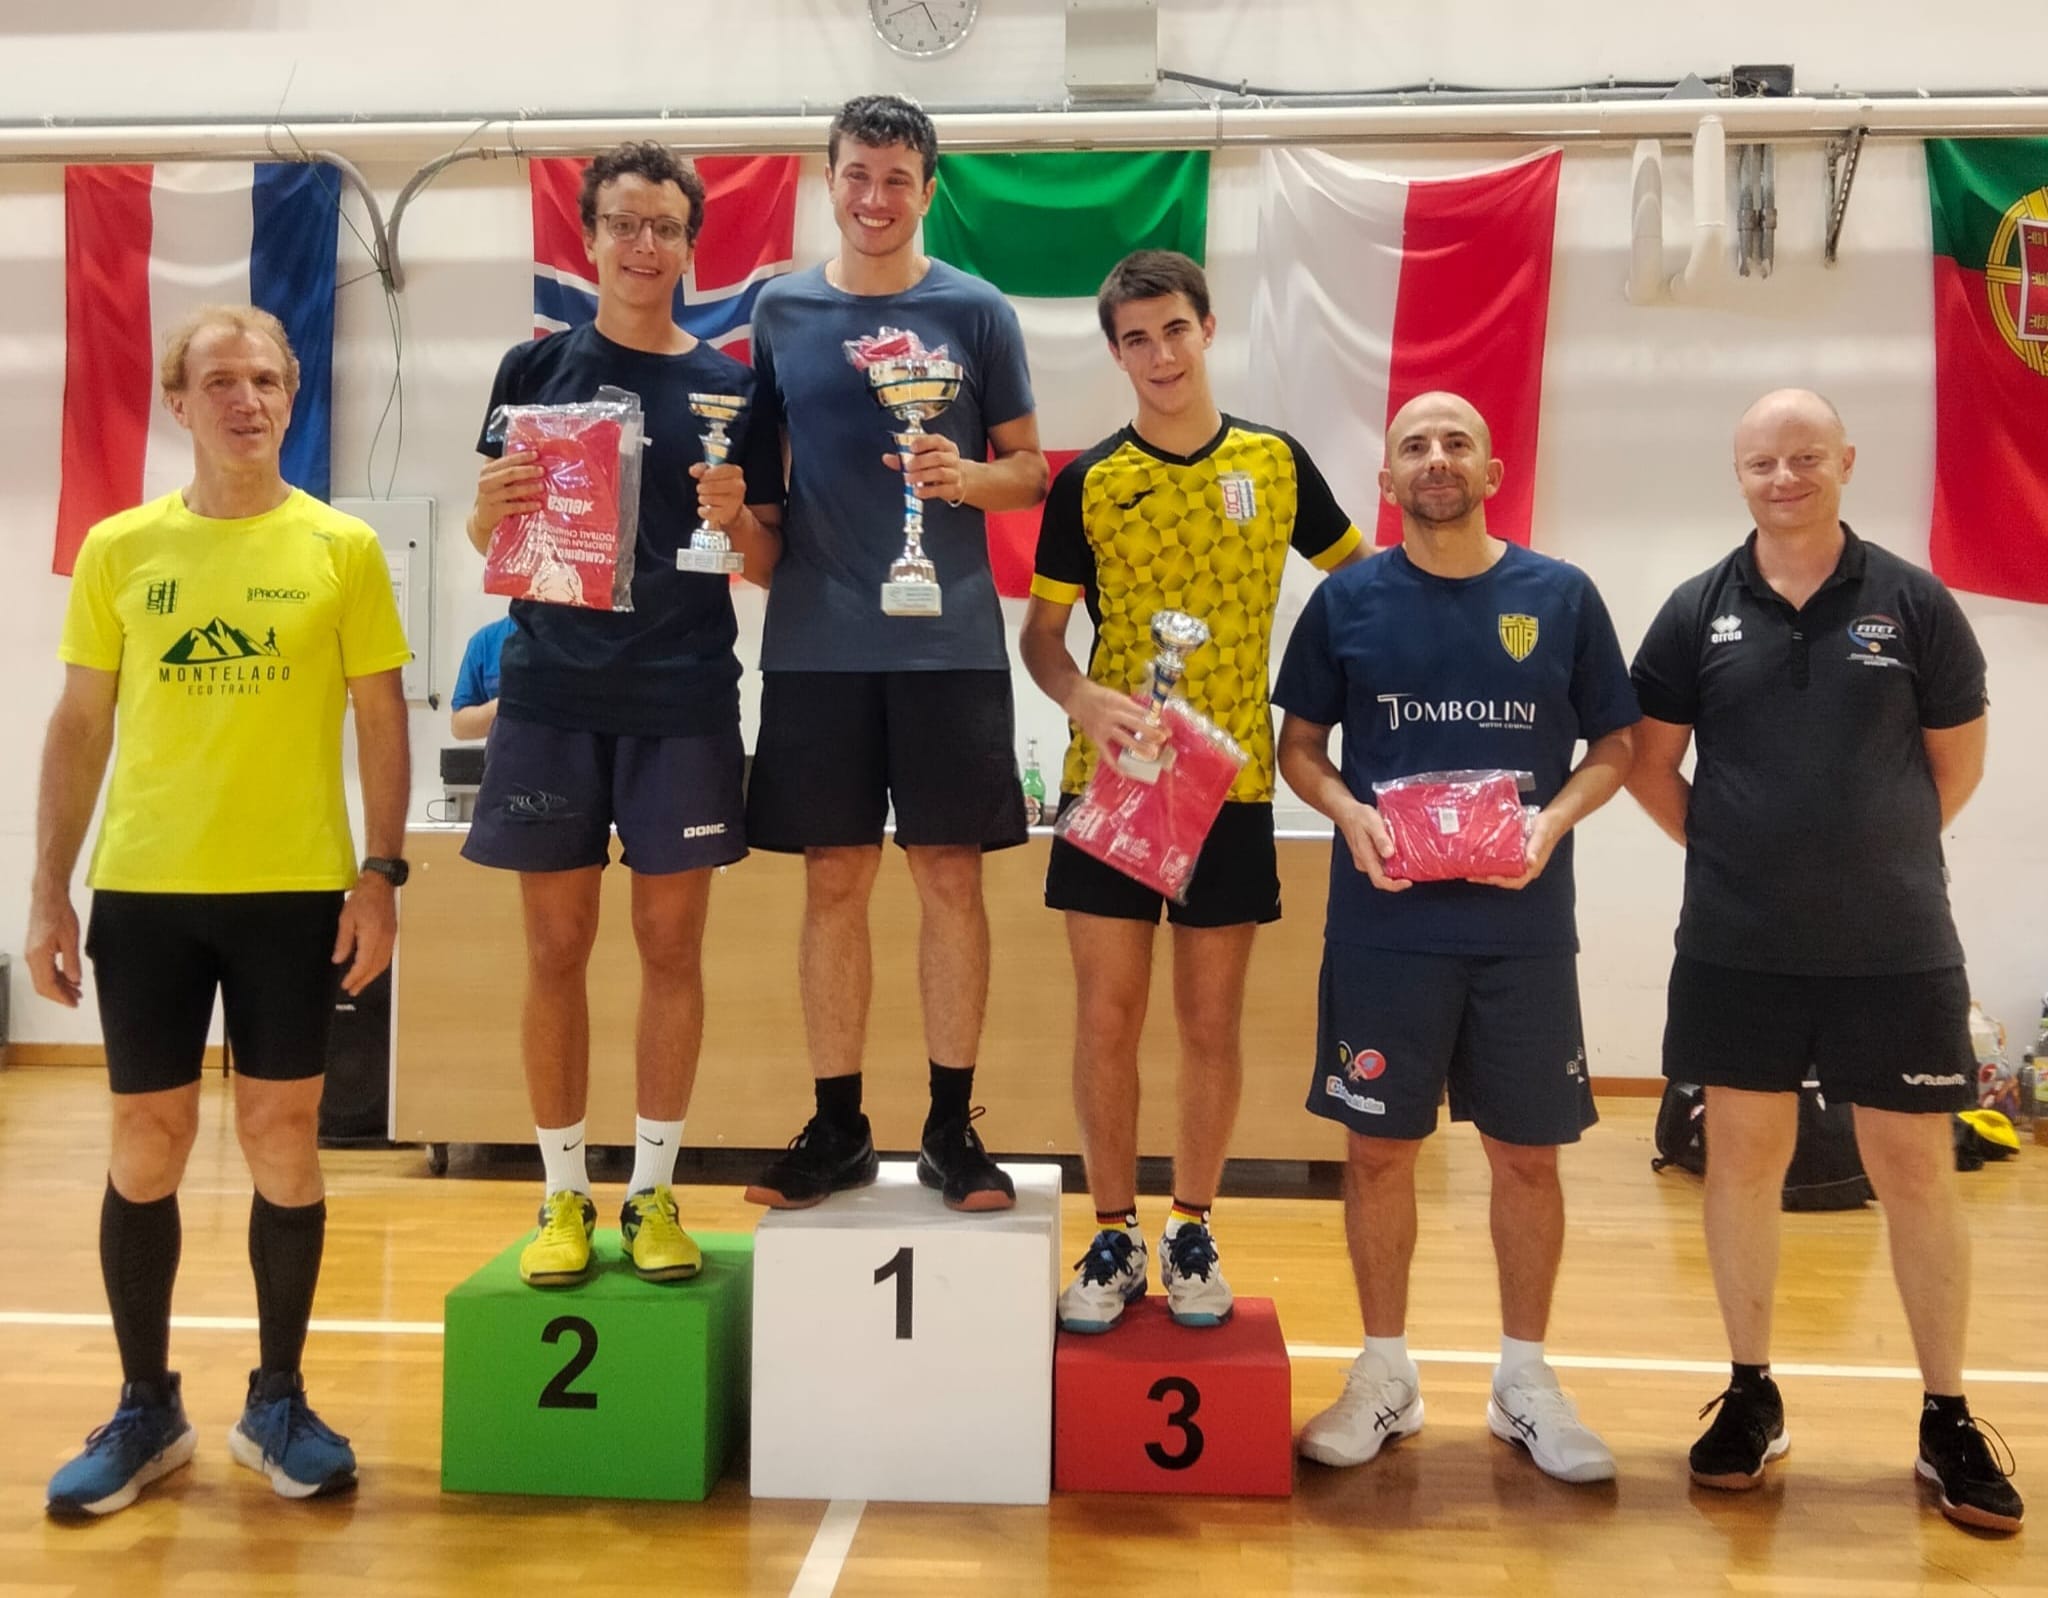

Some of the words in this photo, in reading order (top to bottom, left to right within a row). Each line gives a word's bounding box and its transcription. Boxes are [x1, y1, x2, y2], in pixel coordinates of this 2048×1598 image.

[159, 665, 290, 683] MONTELAGO
[188, 684, 213, 696] ECO
[221, 683, 261, 696] TRAIL
[1376, 692, 1536, 731] TOMBOLINI
[683, 823, 726, 838] DONIC
[874, 1246, 913, 1340] 1
[539, 1315, 598, 1409] 2
[1144, 1376, 1204, 1471] 3
